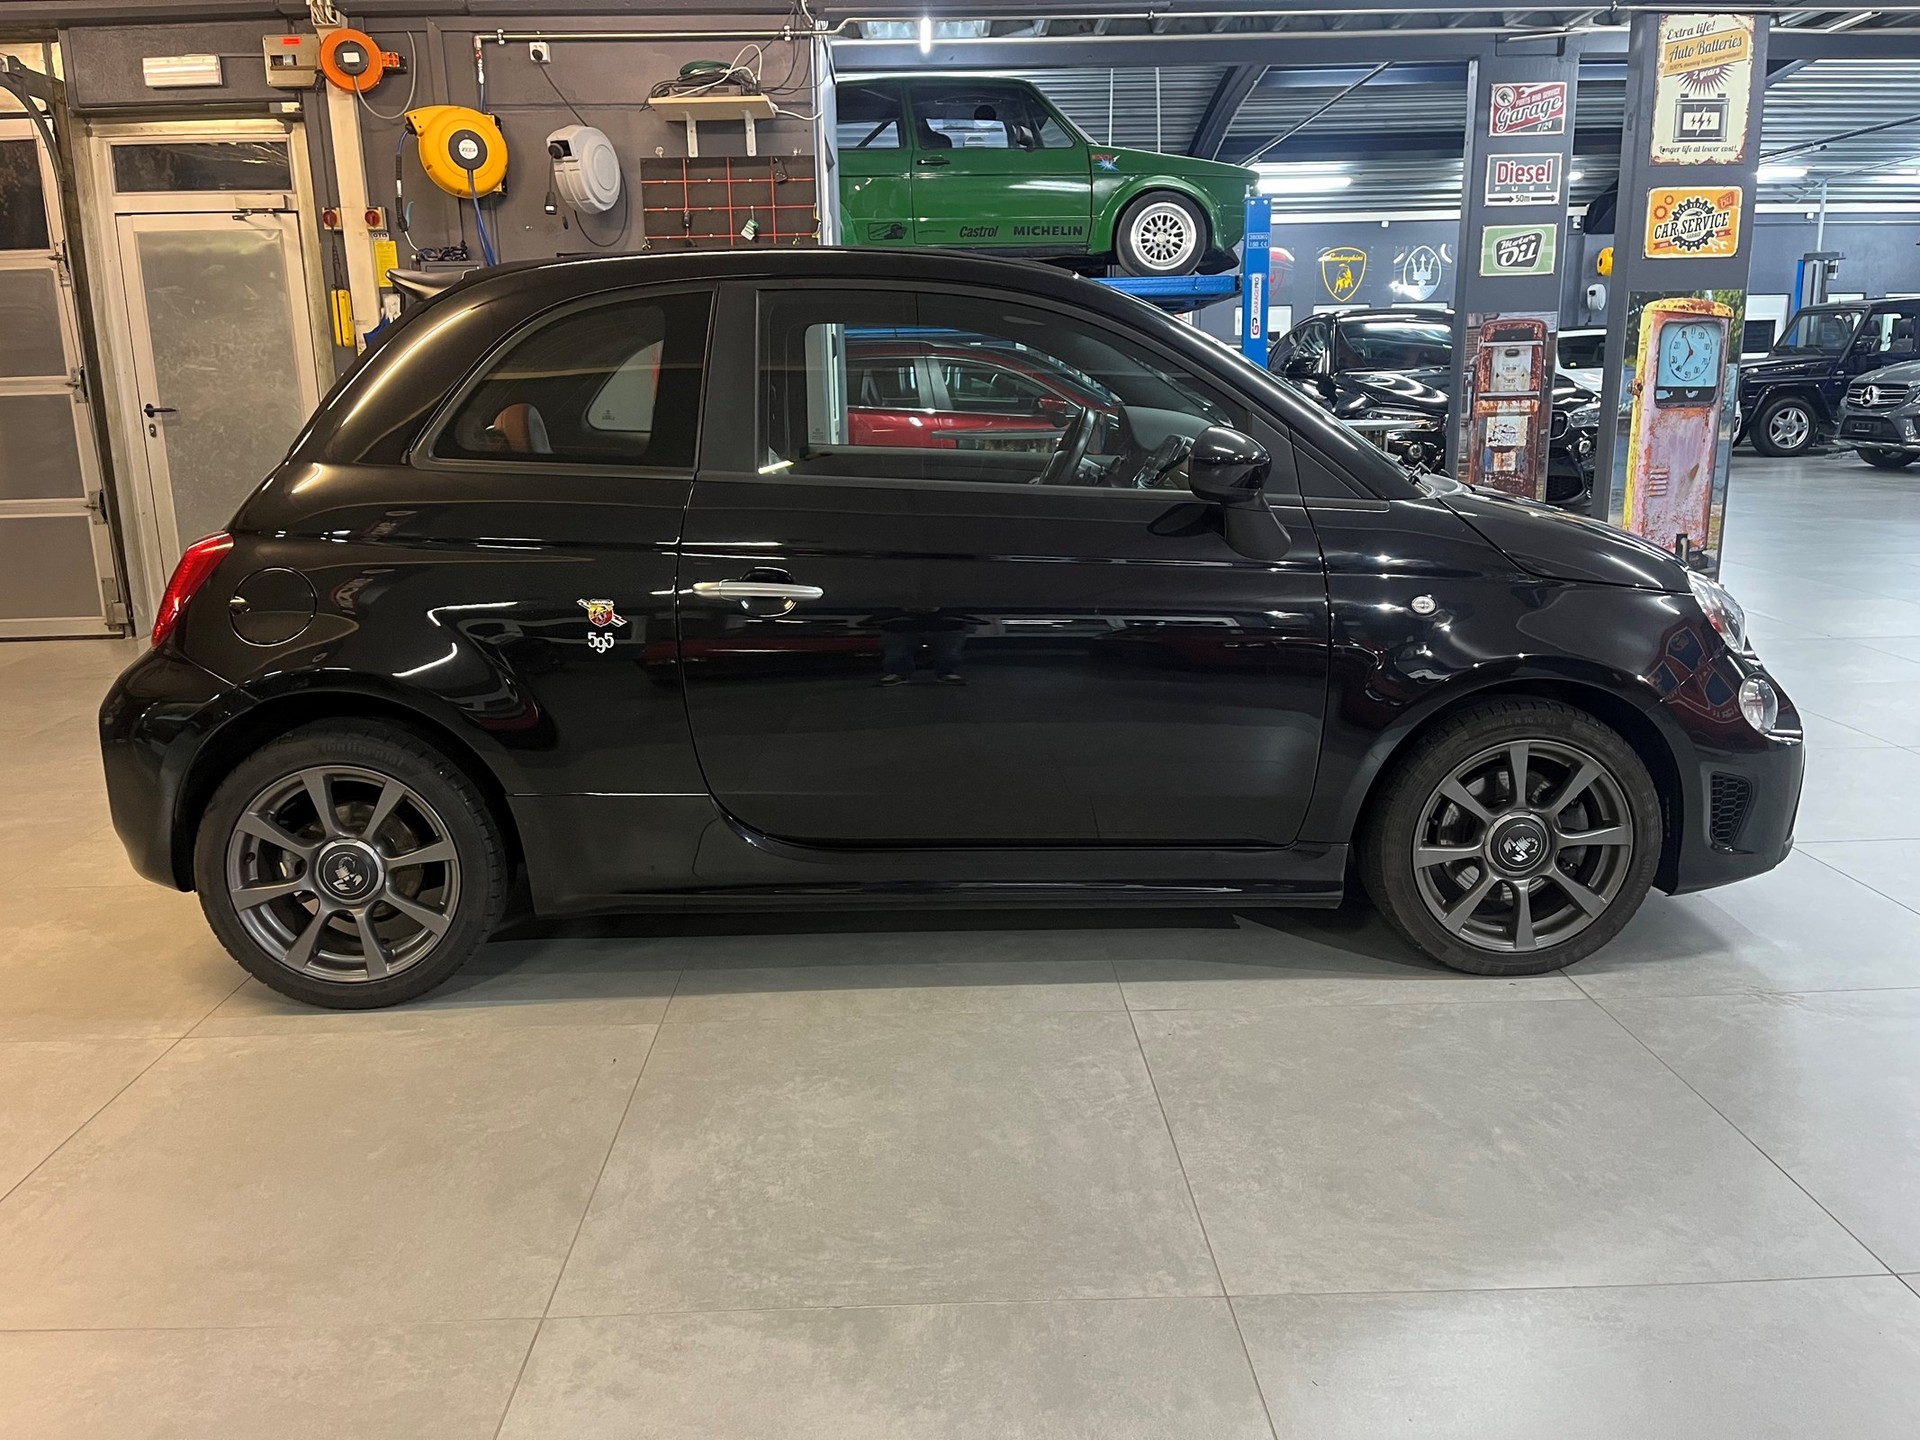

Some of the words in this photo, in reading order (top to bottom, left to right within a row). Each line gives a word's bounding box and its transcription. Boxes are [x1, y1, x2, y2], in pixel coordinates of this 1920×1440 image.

[1667, 27, 1693, 40] Extra
[1696, 20, 1716, 36] life!
[1669, 45, 1694, 63] Auto
[1697, 35, 1742, 55] Batteries
[1693, 70, 1699, 79] 2
[1700, 67, 1720, 80] years
[1497, 97, 1561, 131] Garage
[1658, 145, 1681, 155] Longer
[1682, 145, 1692, 154] life
[1496, 159, 1552, 184] Diesel
[1515, 194, 1530, 202] 50m
[960, 225, 999, 238] Castrol
[1013, 225, 1083, 236] MICHELIN
[1654, 221, 1679, 239] CAR
[1681, 212, 1729, 234] SERVICE
[1500, 234, 1537, 250] Motor
[1499, 242, 1537, 266] Oil
[587, 631, 615, 654] 595
